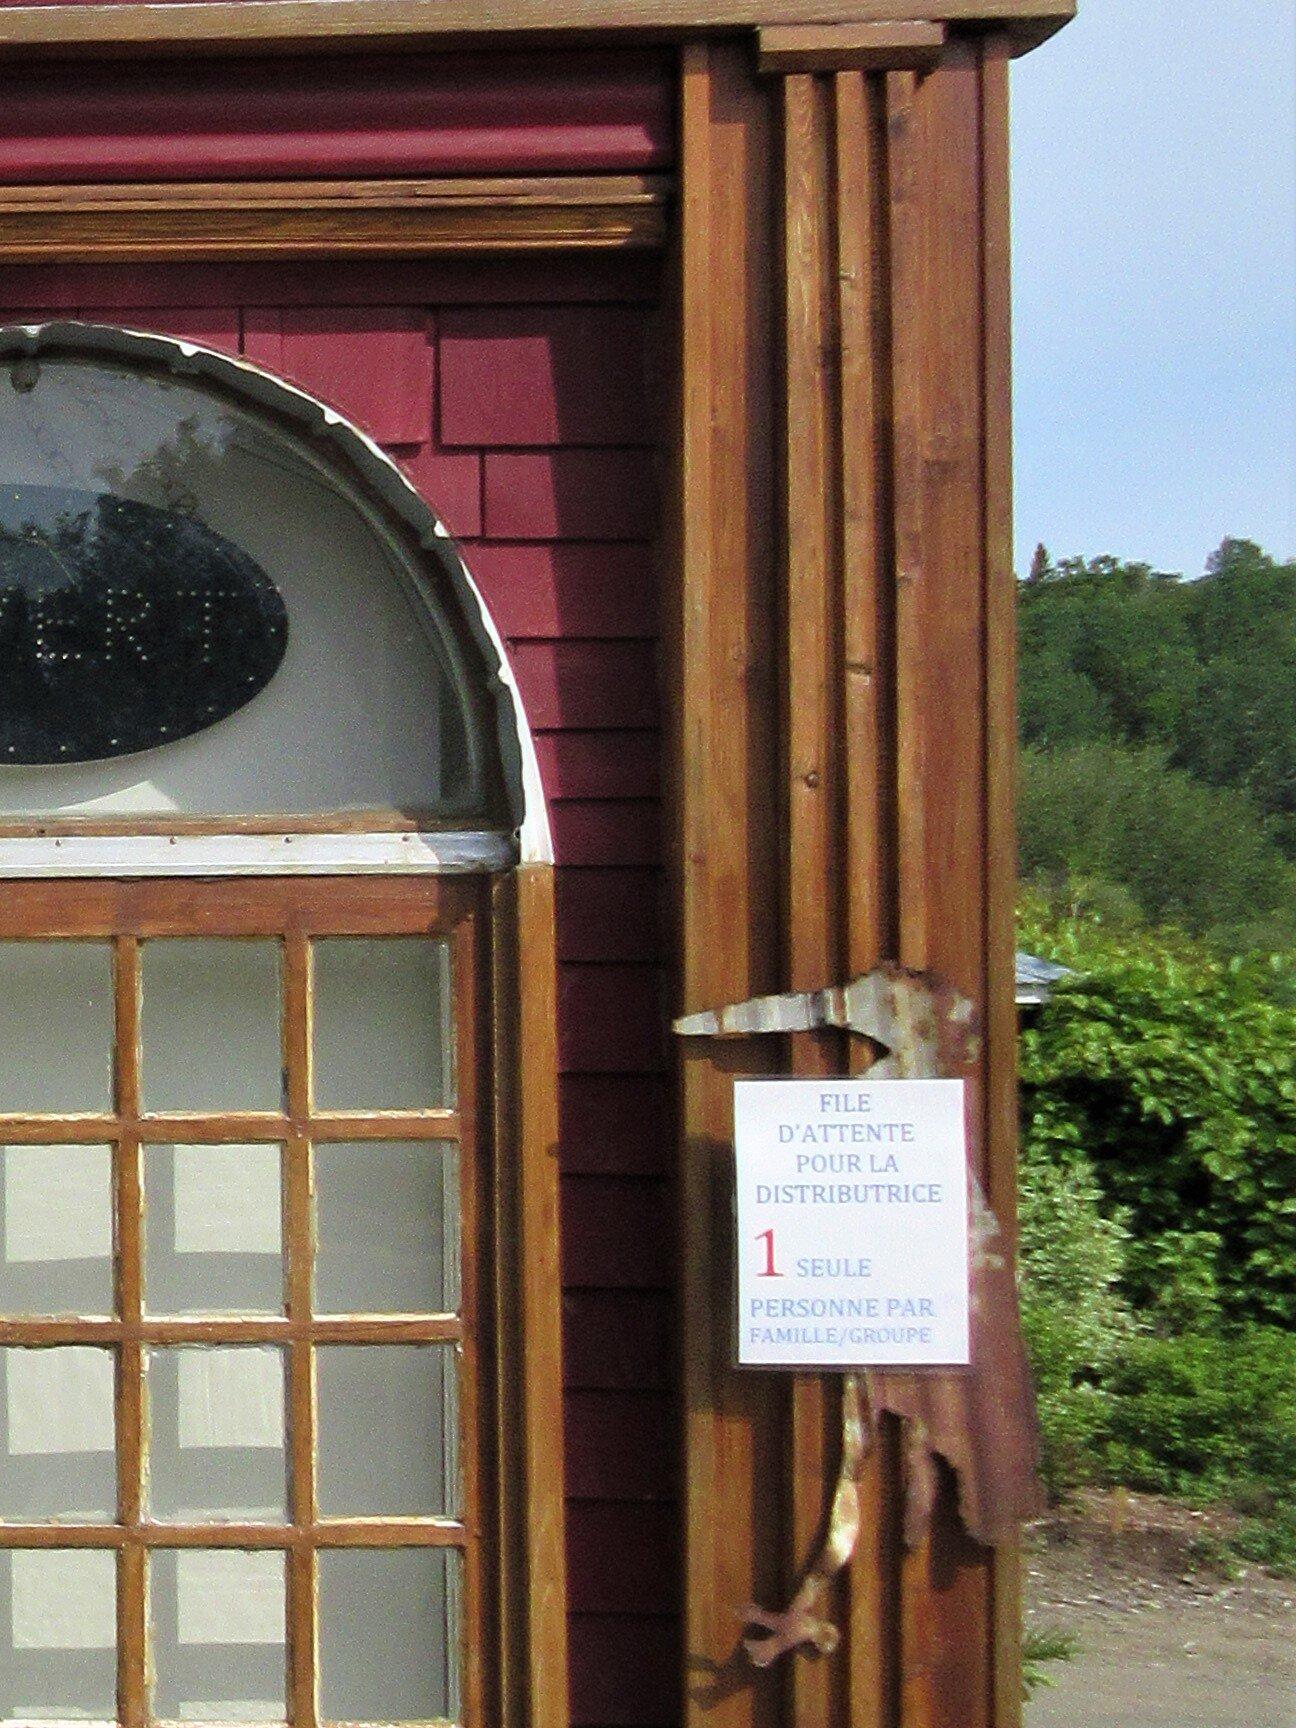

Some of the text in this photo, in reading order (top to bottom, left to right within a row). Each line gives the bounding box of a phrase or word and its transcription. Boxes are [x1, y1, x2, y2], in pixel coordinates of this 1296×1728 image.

[819, 1093, 872, 1114] FILE
[778, 1123, 916, 1145] D'ATTENTE
[796, 1154, 900, 1174] POUR LA
[755, 1183, 943, 1205] DISTRIBUTRICE
[753, 1228, 873, 1278] 1 SEULE
[750, 1298, 937, 1319] PERSONNE PAR
[750, 1326, 932, 1347] FAMILLE/GROUPE
